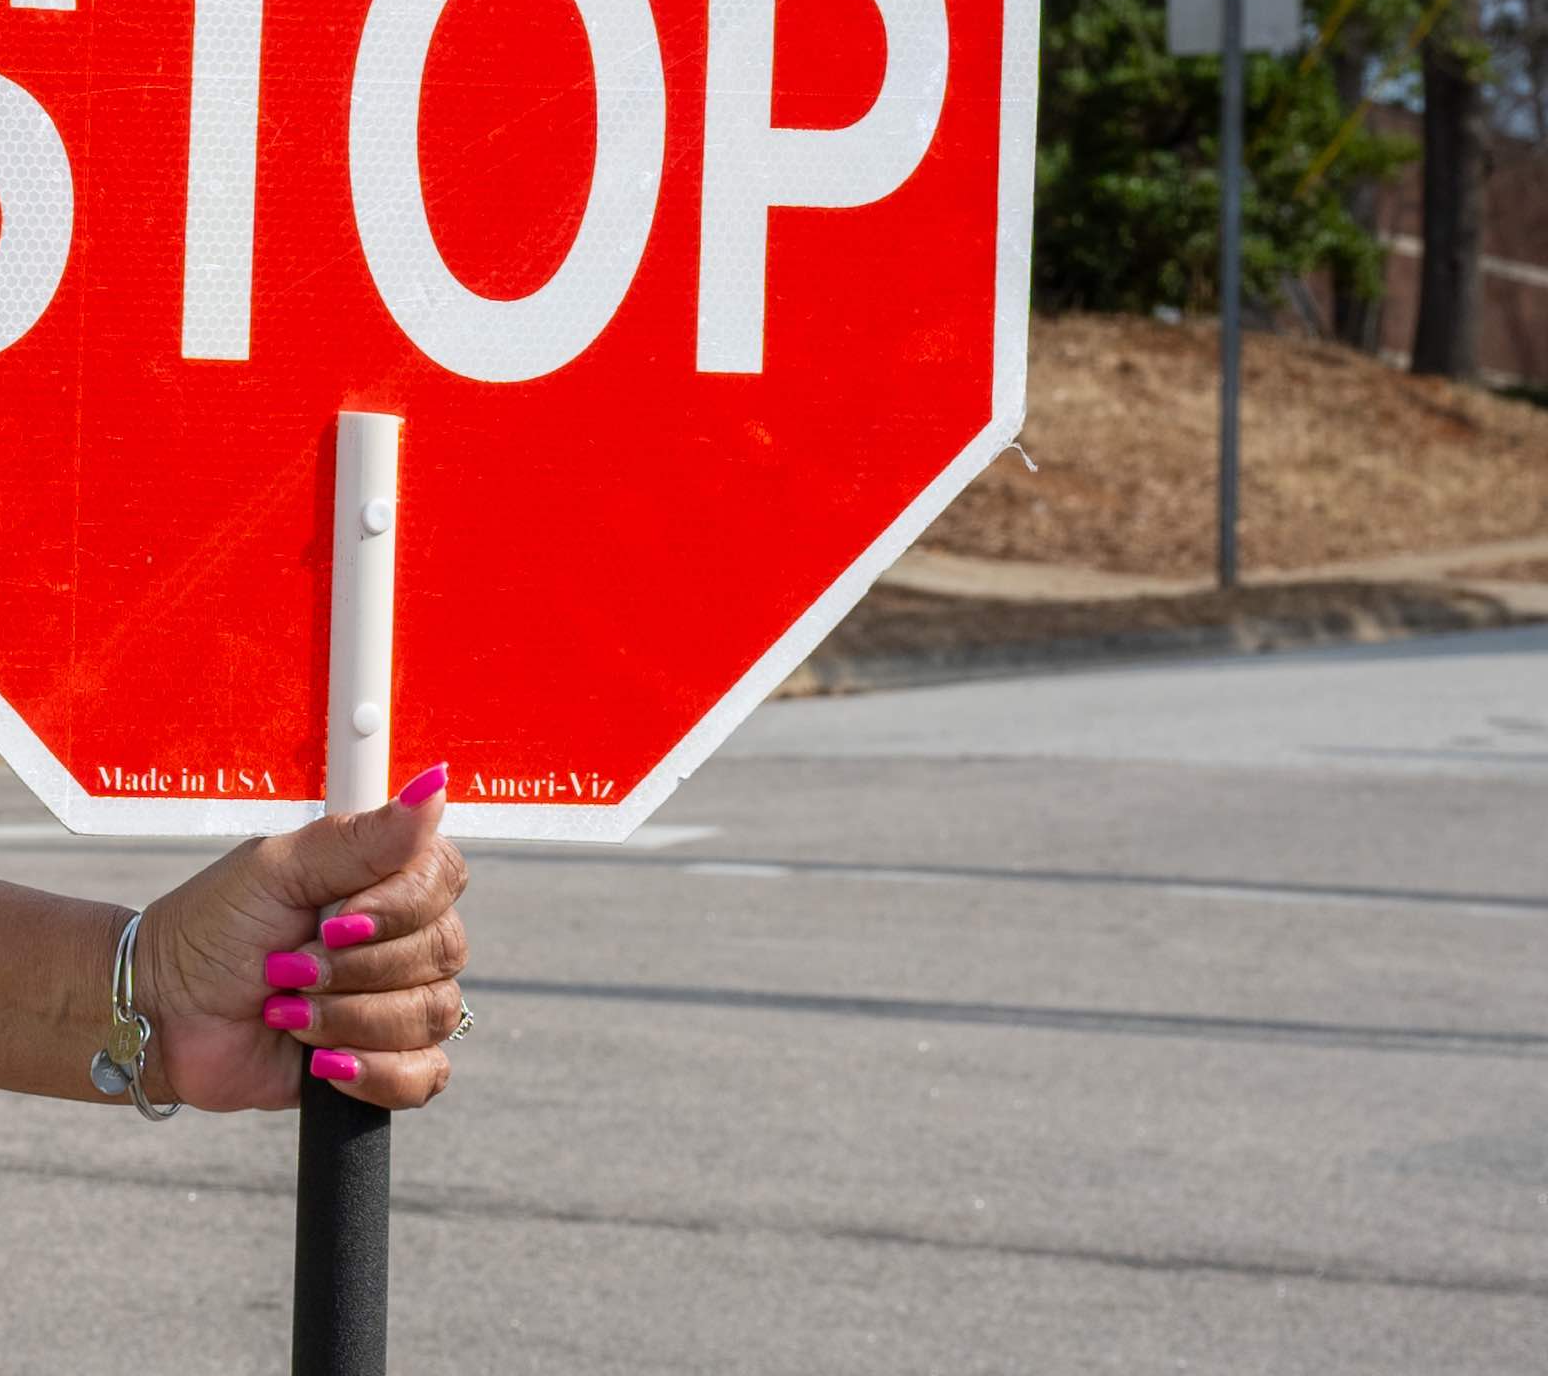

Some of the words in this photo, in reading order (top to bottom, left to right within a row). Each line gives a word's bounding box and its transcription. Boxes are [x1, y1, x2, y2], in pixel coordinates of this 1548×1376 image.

[96, 766, 173, 792] Made
[180, 767, 206, 793] in
[216, 768, 277, 794] USA
[465, 771, 615, 799] Ameri-Viz
